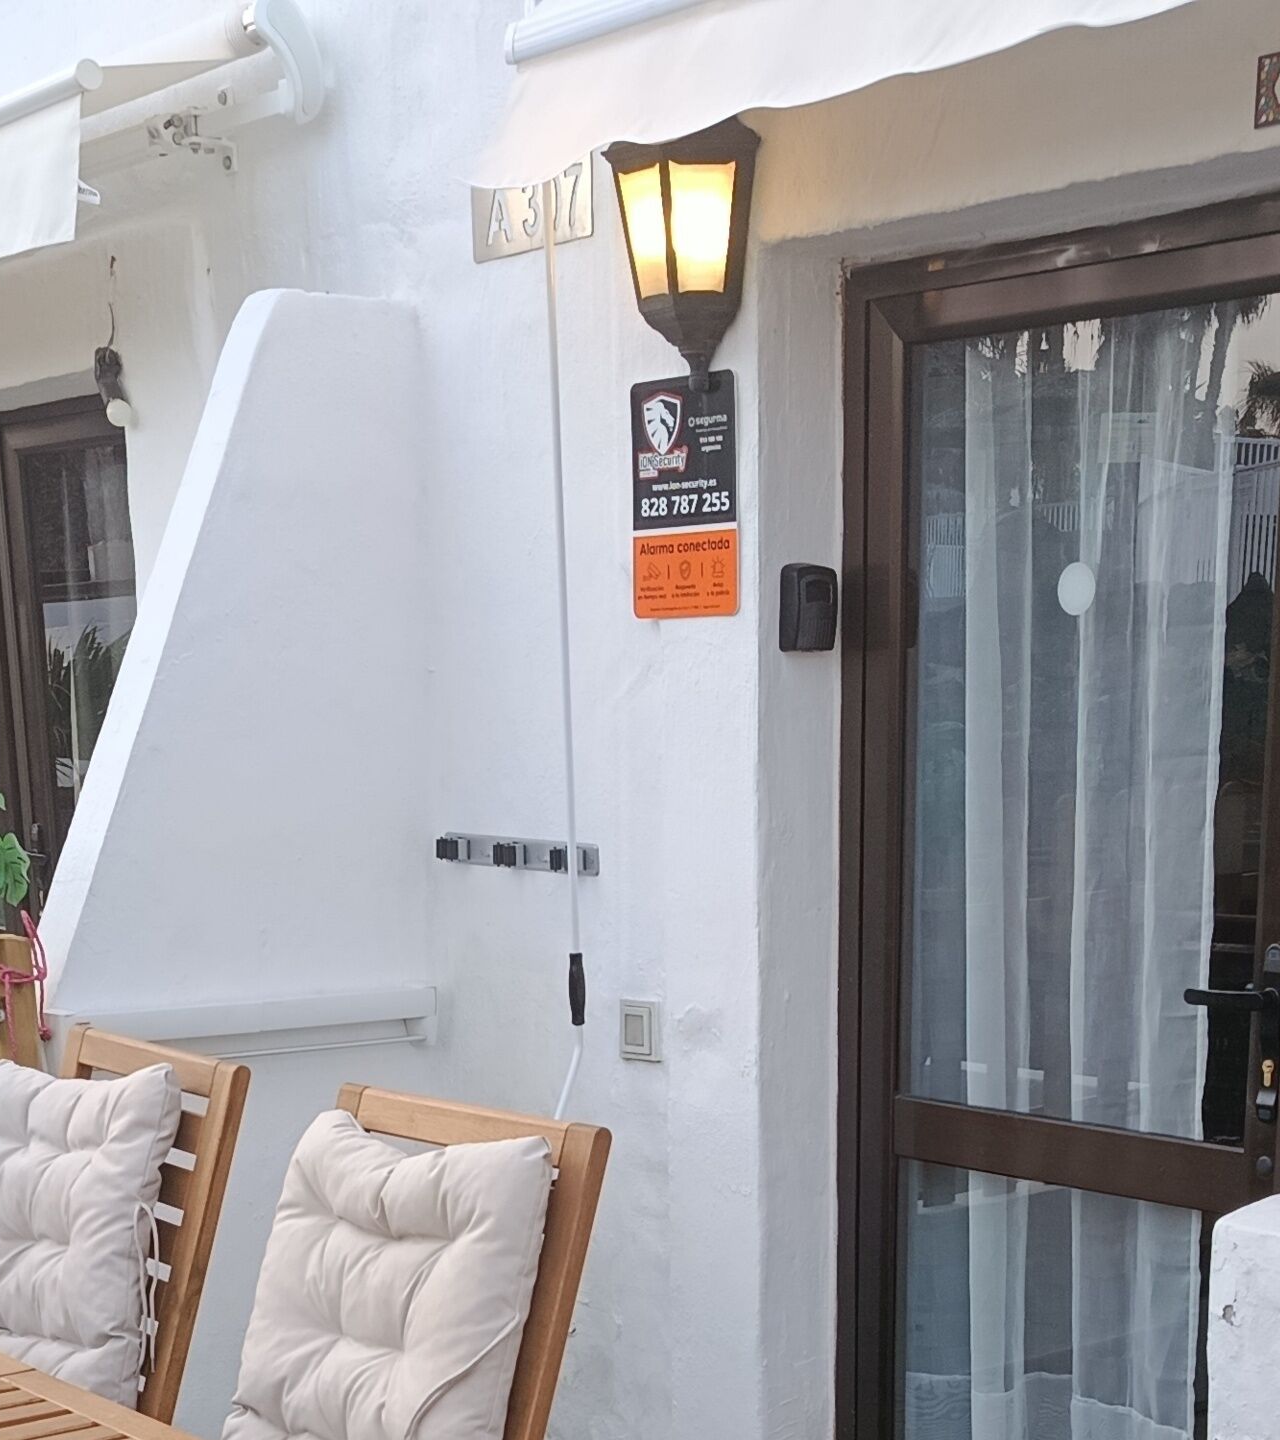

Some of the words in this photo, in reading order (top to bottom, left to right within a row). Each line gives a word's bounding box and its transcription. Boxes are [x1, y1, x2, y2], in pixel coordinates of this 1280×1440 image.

[641, 498, 668, 517] 828
[671, 494, 698, 515] 787
[702, 491, 730, 513] 255
[639, 541, 674, 556] Alarma
[676, 538, 730, 553] conectada
